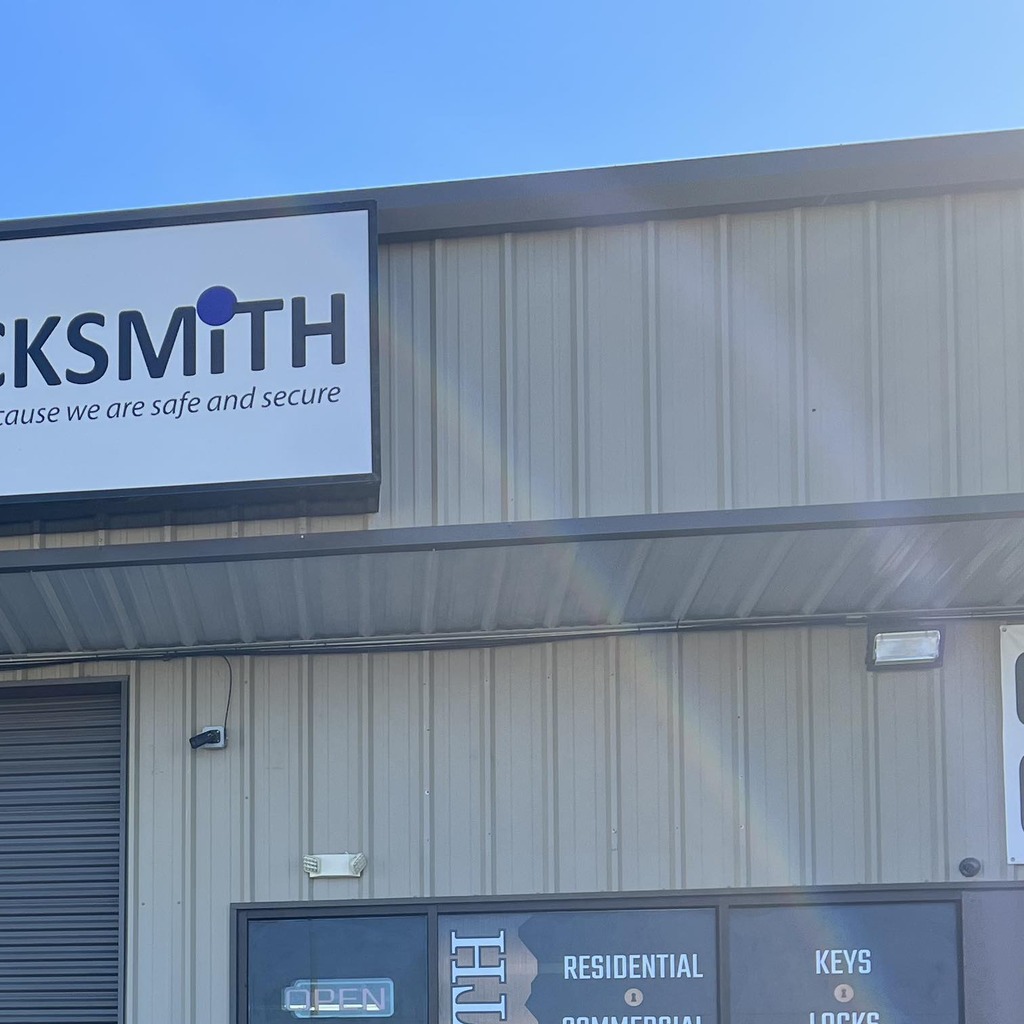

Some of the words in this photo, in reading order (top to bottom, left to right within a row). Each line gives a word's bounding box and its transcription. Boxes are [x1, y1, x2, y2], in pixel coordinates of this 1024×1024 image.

[67, 404, 98, 421] we
[107, 400, 145, 418] are
[151, 391, 201, 420] safe
[207, 386, 256, 412] and
[261, 385, 341, 408] secure
[563, 953, 704, 980] RESIDENTIAL
[815, 949, 872, 975] KEYS
[285, 987, 386, 1011] OPEN
